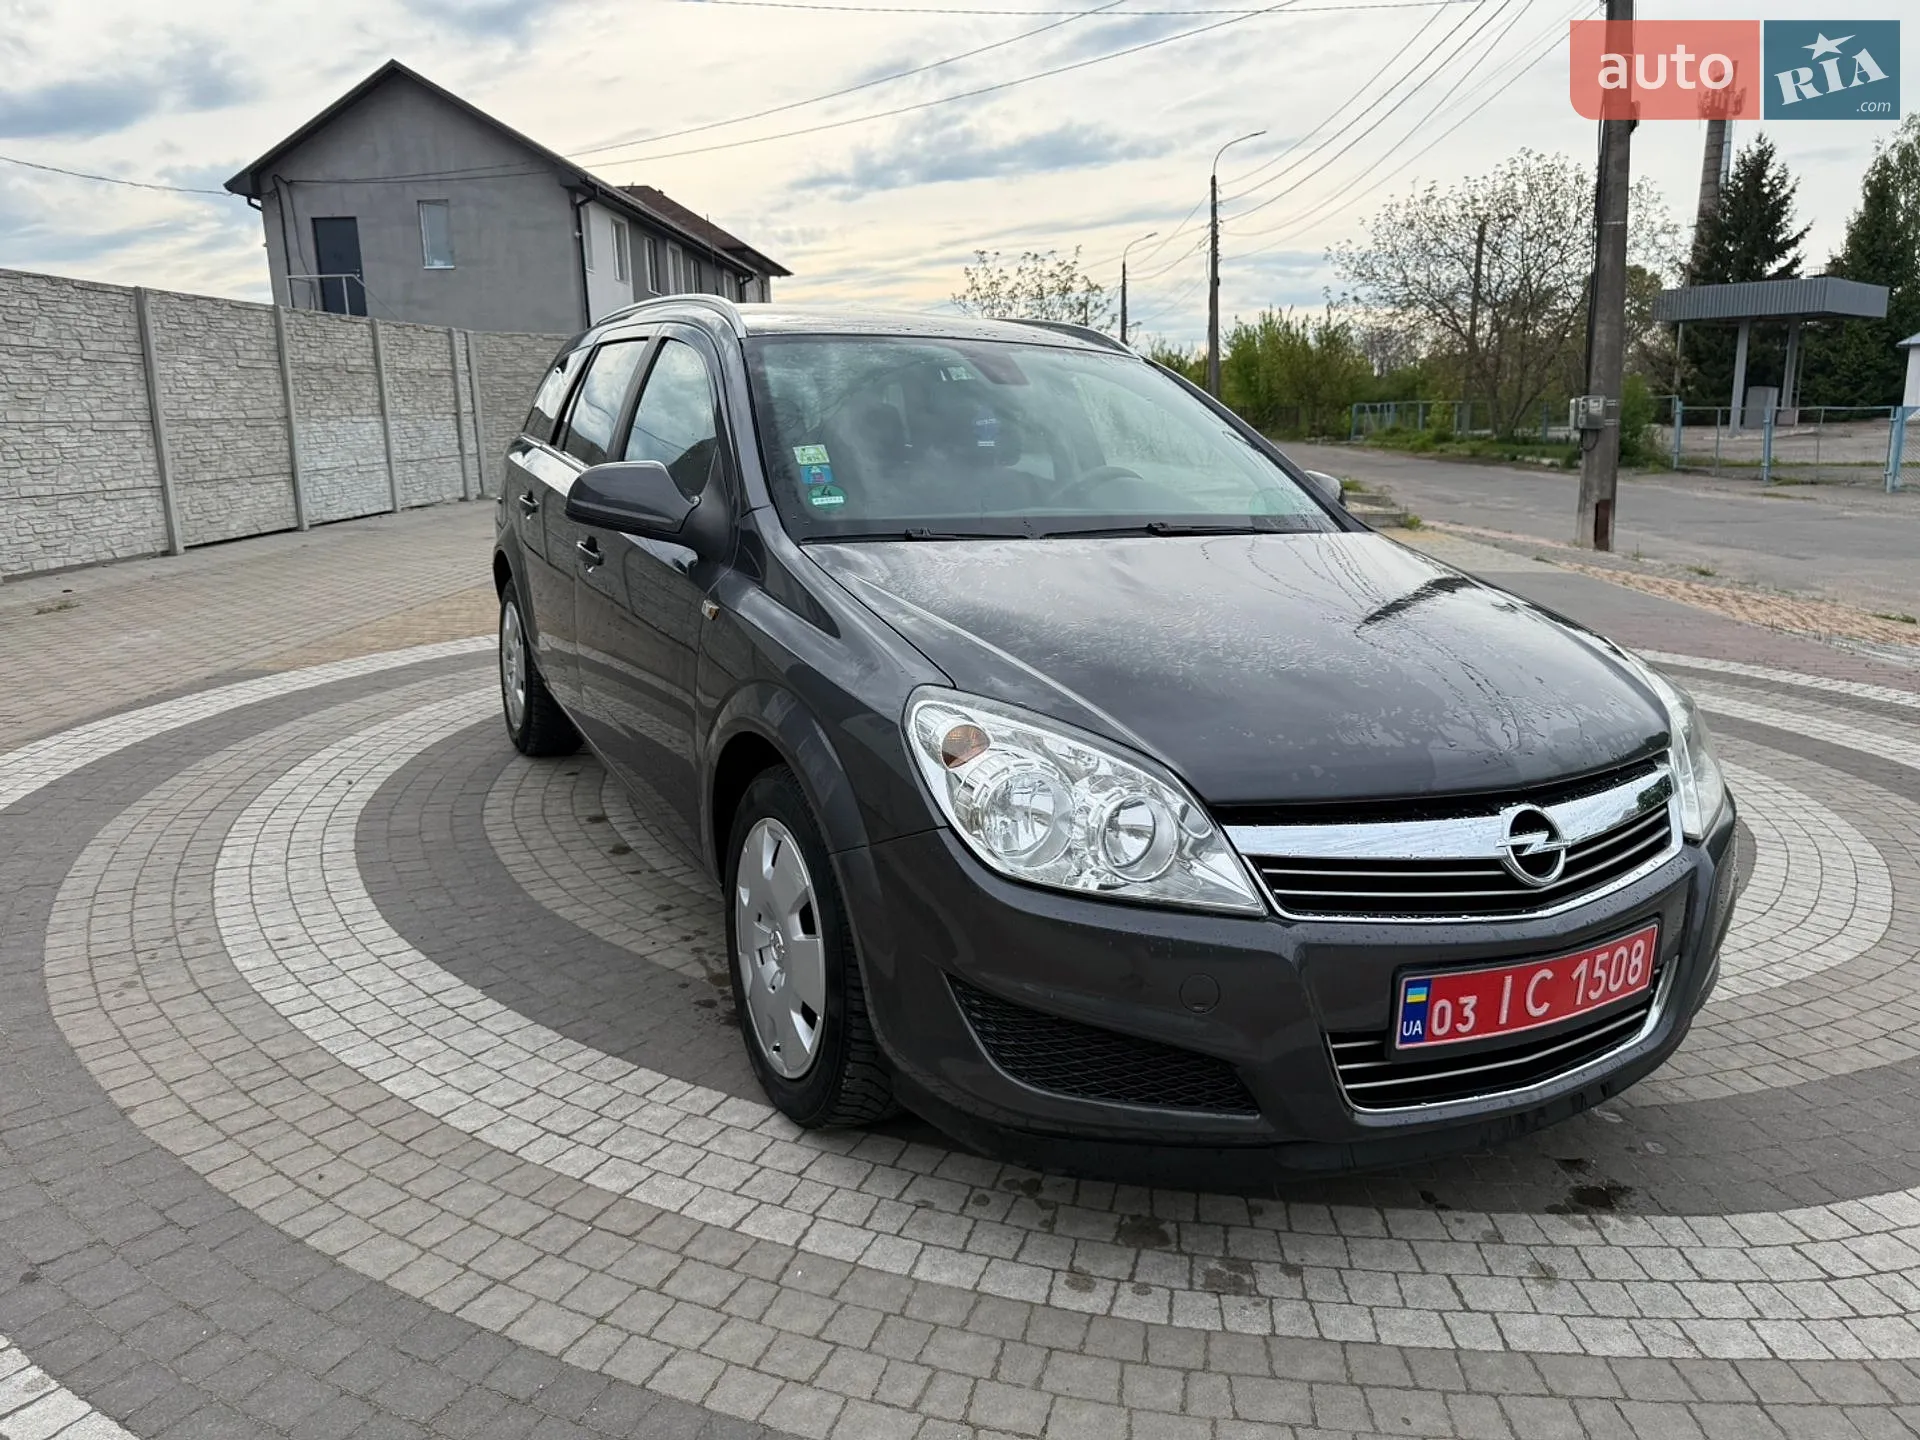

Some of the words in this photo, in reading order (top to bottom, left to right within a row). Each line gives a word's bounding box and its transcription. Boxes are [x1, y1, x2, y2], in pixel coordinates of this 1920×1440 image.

[1430, 995, 1477, 1036] 03
[1570, 939, 1645, 1006] 1508
[1402, 1020, 1423, 1038] UA
